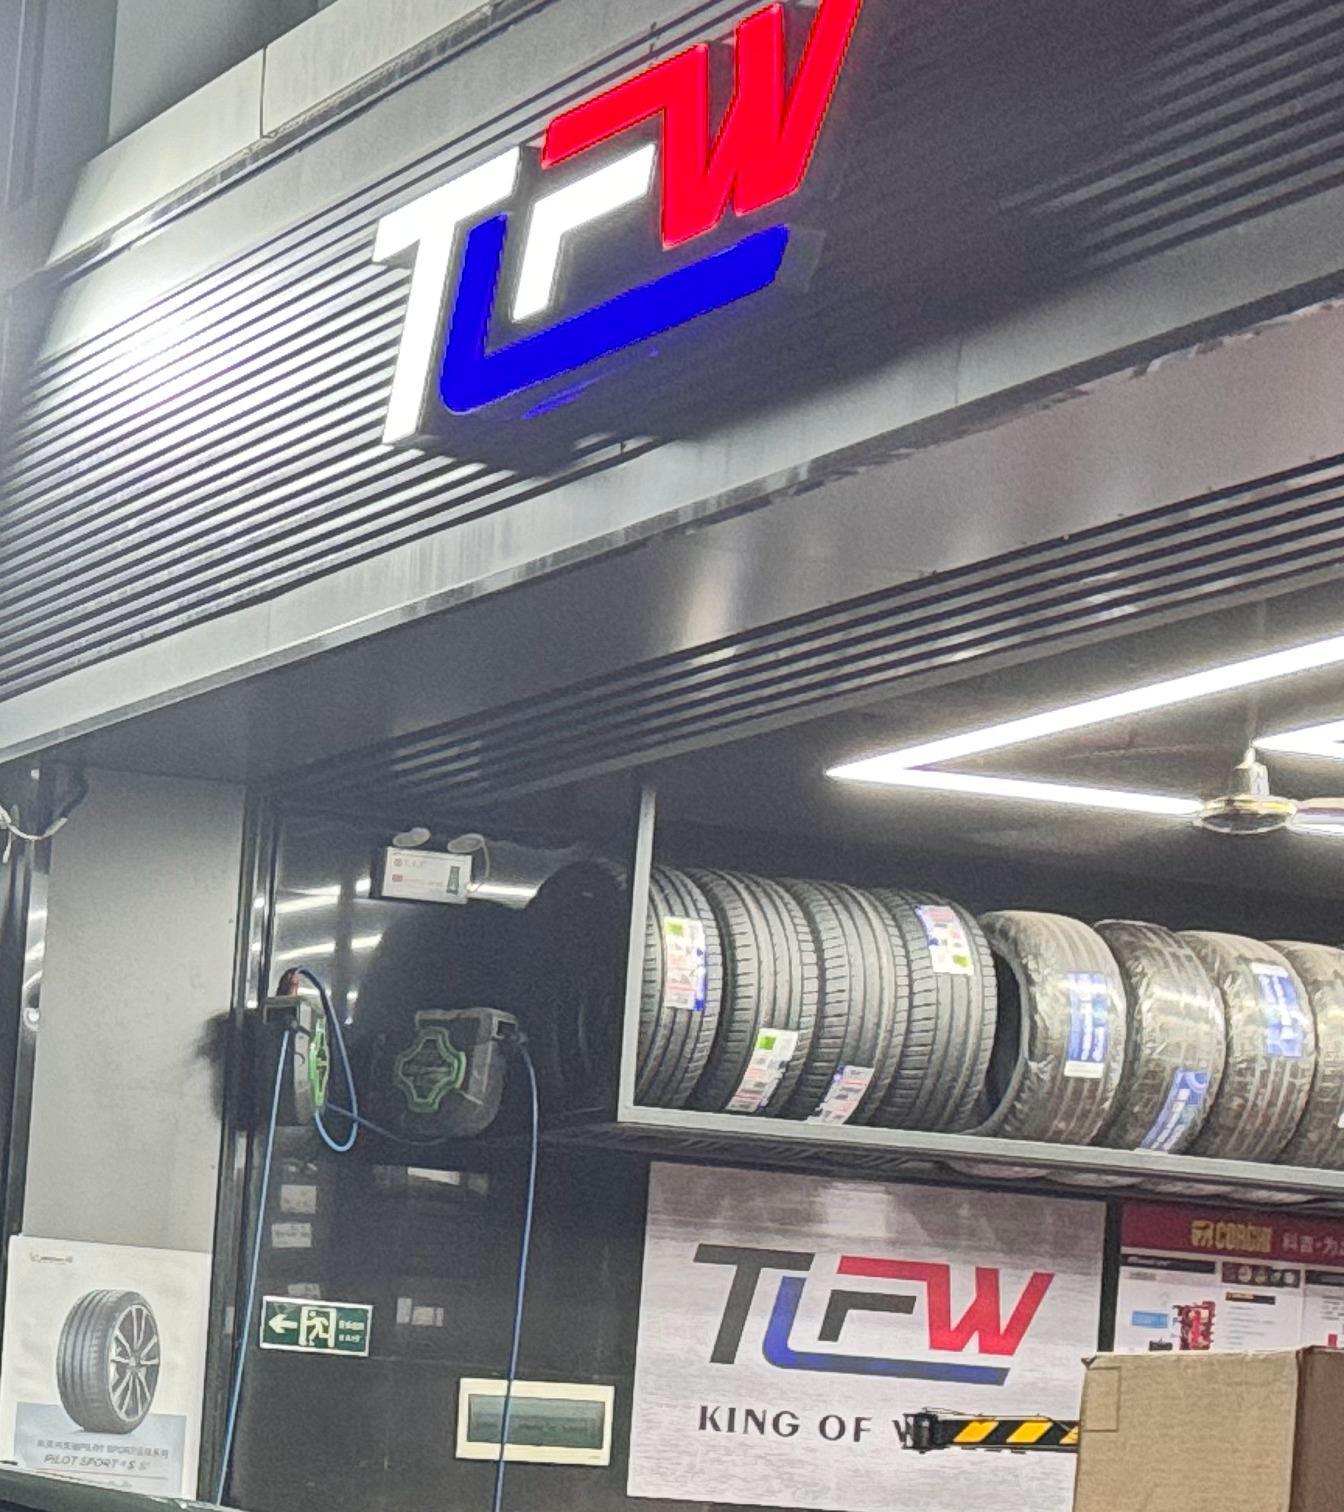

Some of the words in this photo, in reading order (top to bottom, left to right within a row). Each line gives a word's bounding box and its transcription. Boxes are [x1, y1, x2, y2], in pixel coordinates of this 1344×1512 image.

[698, 1404, 801, 1438] KING
[818, 1413, 873, 1443] OF
[43, 1453, 78, 1467] PILOT
[80, 1455, 119, 1469] SPORT
